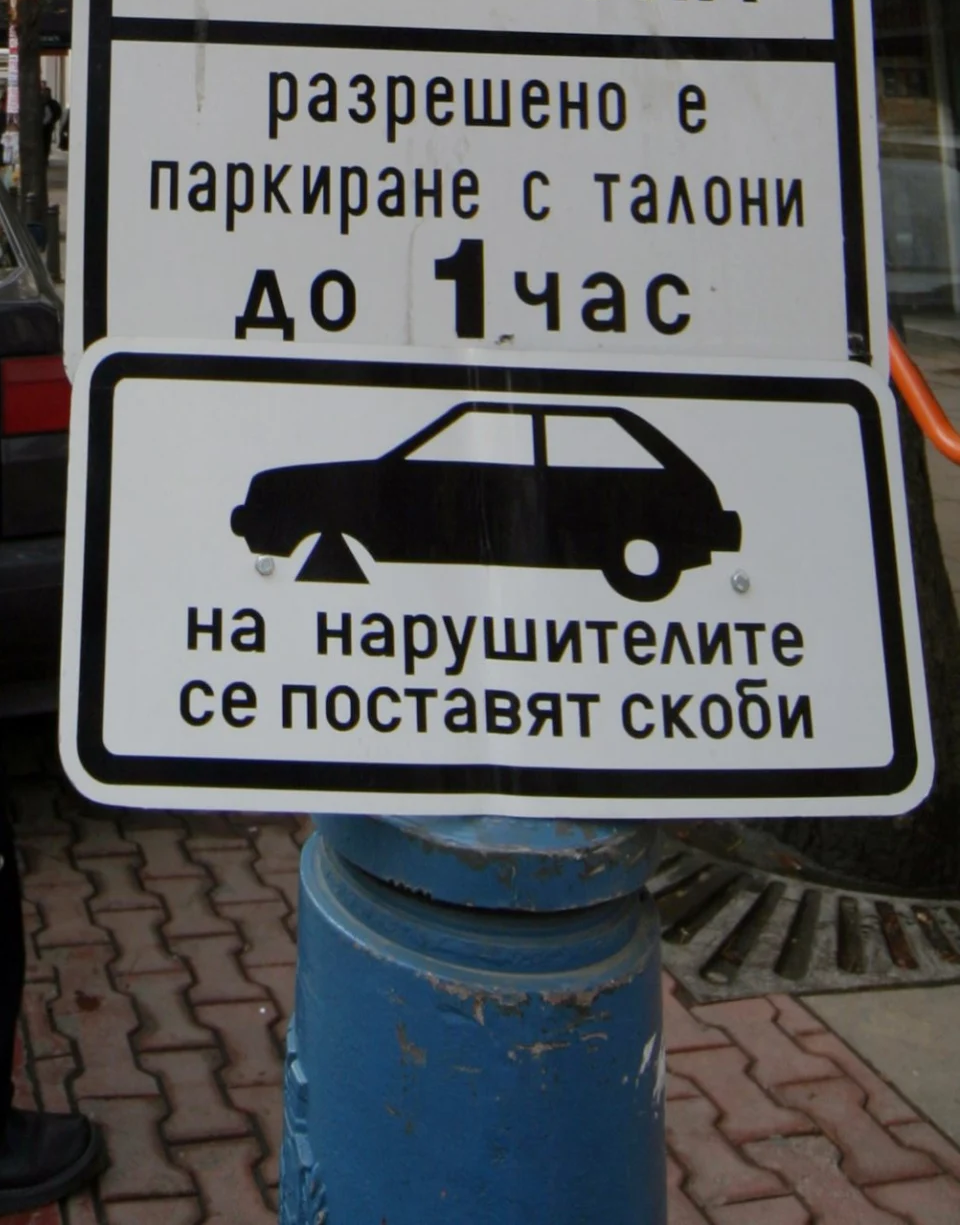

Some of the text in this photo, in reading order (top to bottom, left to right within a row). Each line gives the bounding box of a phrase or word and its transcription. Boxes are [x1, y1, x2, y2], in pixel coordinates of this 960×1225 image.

[268, 71, 707, 144] разрешено е
[150, 160, 804, 236] паркиране с талони
[234, 238, 691, 342] до 1 час
[187, 606, 804, 676] на нарушителите
[179, 678, 814, 740] се поставят скоби
